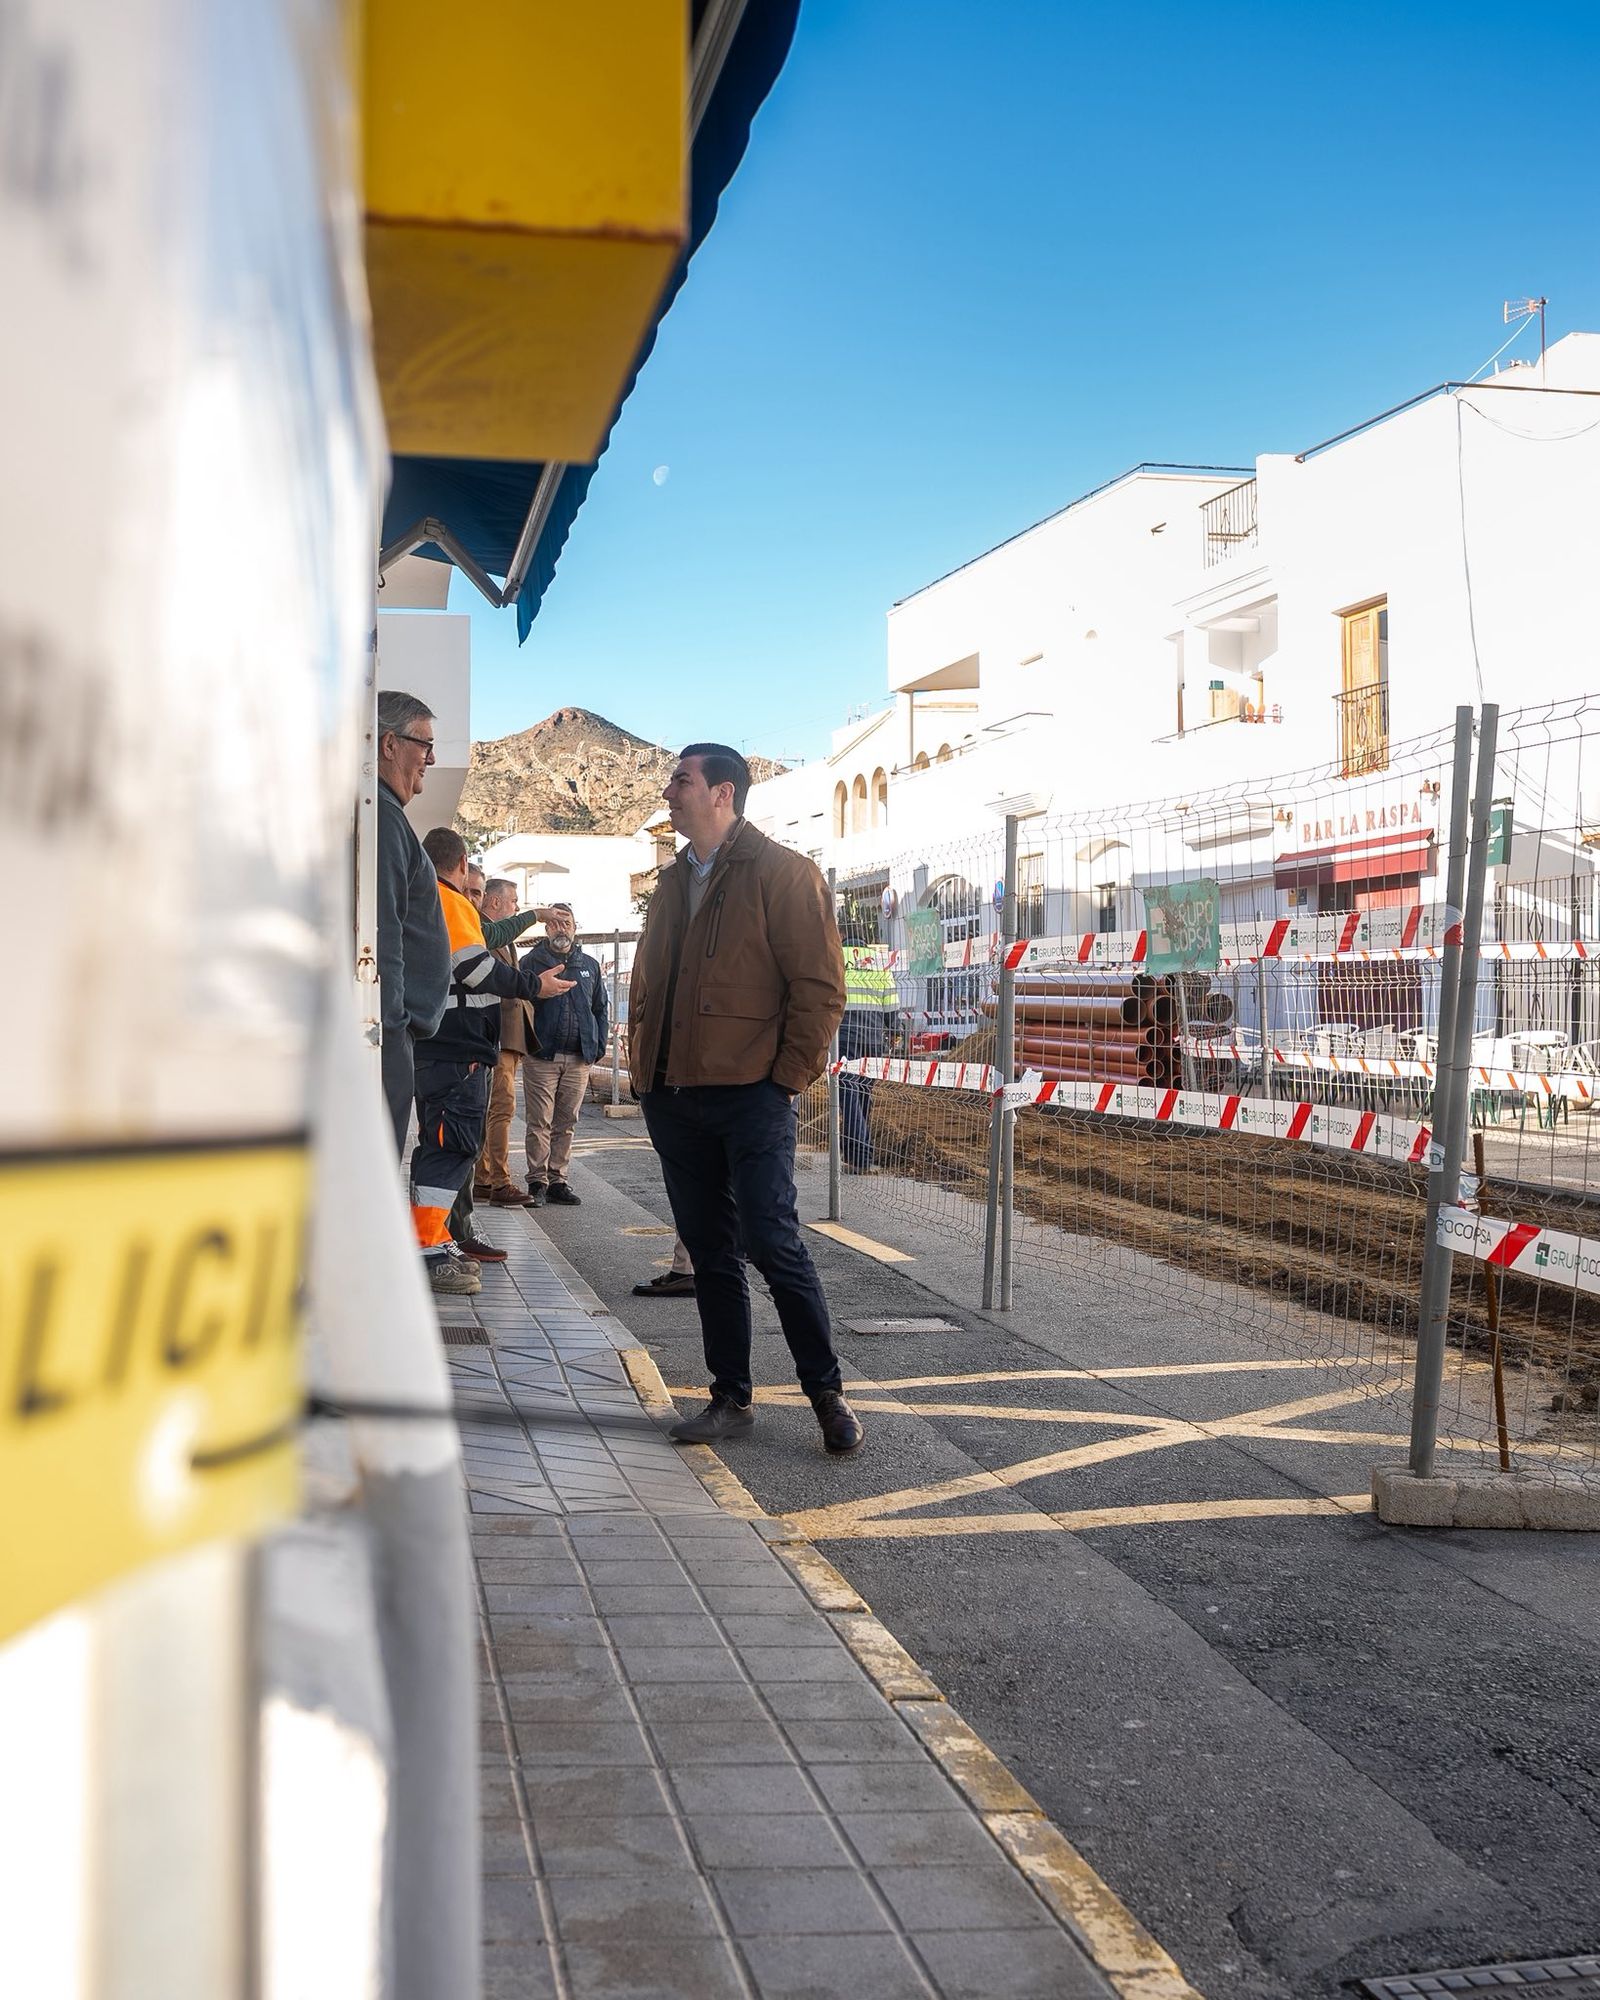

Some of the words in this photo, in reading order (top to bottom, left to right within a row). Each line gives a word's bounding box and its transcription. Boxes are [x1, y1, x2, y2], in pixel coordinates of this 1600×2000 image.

[1303, 823, 1335, 843] BAR
[1339, 814, 1361, 837] LA
[1365, 801, 1422, 832] RASPA
[1174, 898, 1214, 928] RUPO
[1037, 944, 1077, 959] GRUPOCOPSA
[1222, 932, 1265, 948] GRUPOCOPSA
[1248, 1108, 1289, 1126] GRUPOCOPSA
[14, 1217, 306, 1418] LICI
